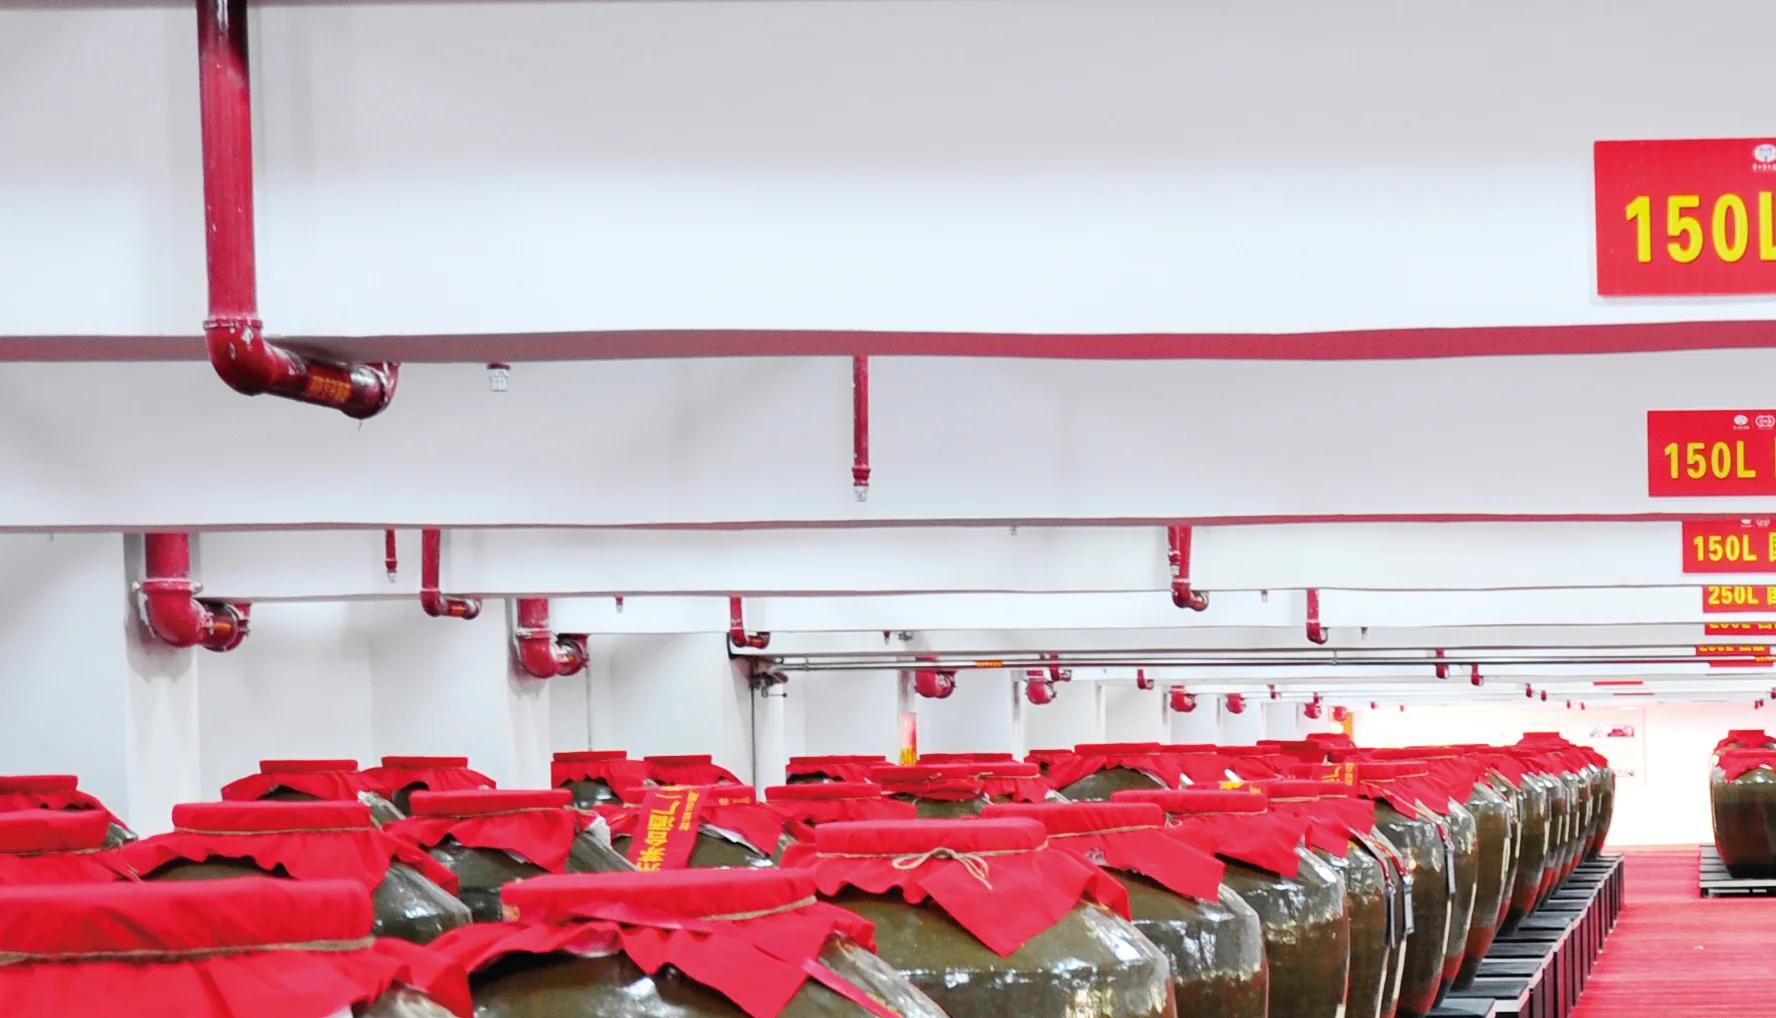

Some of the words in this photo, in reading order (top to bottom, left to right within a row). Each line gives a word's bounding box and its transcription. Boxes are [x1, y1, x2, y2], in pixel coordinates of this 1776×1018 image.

[1664, 440, 1756, 480] 150L
[1693, 533, 1758, 562] 150L
[1708, 586, 1760, 605] 250L
